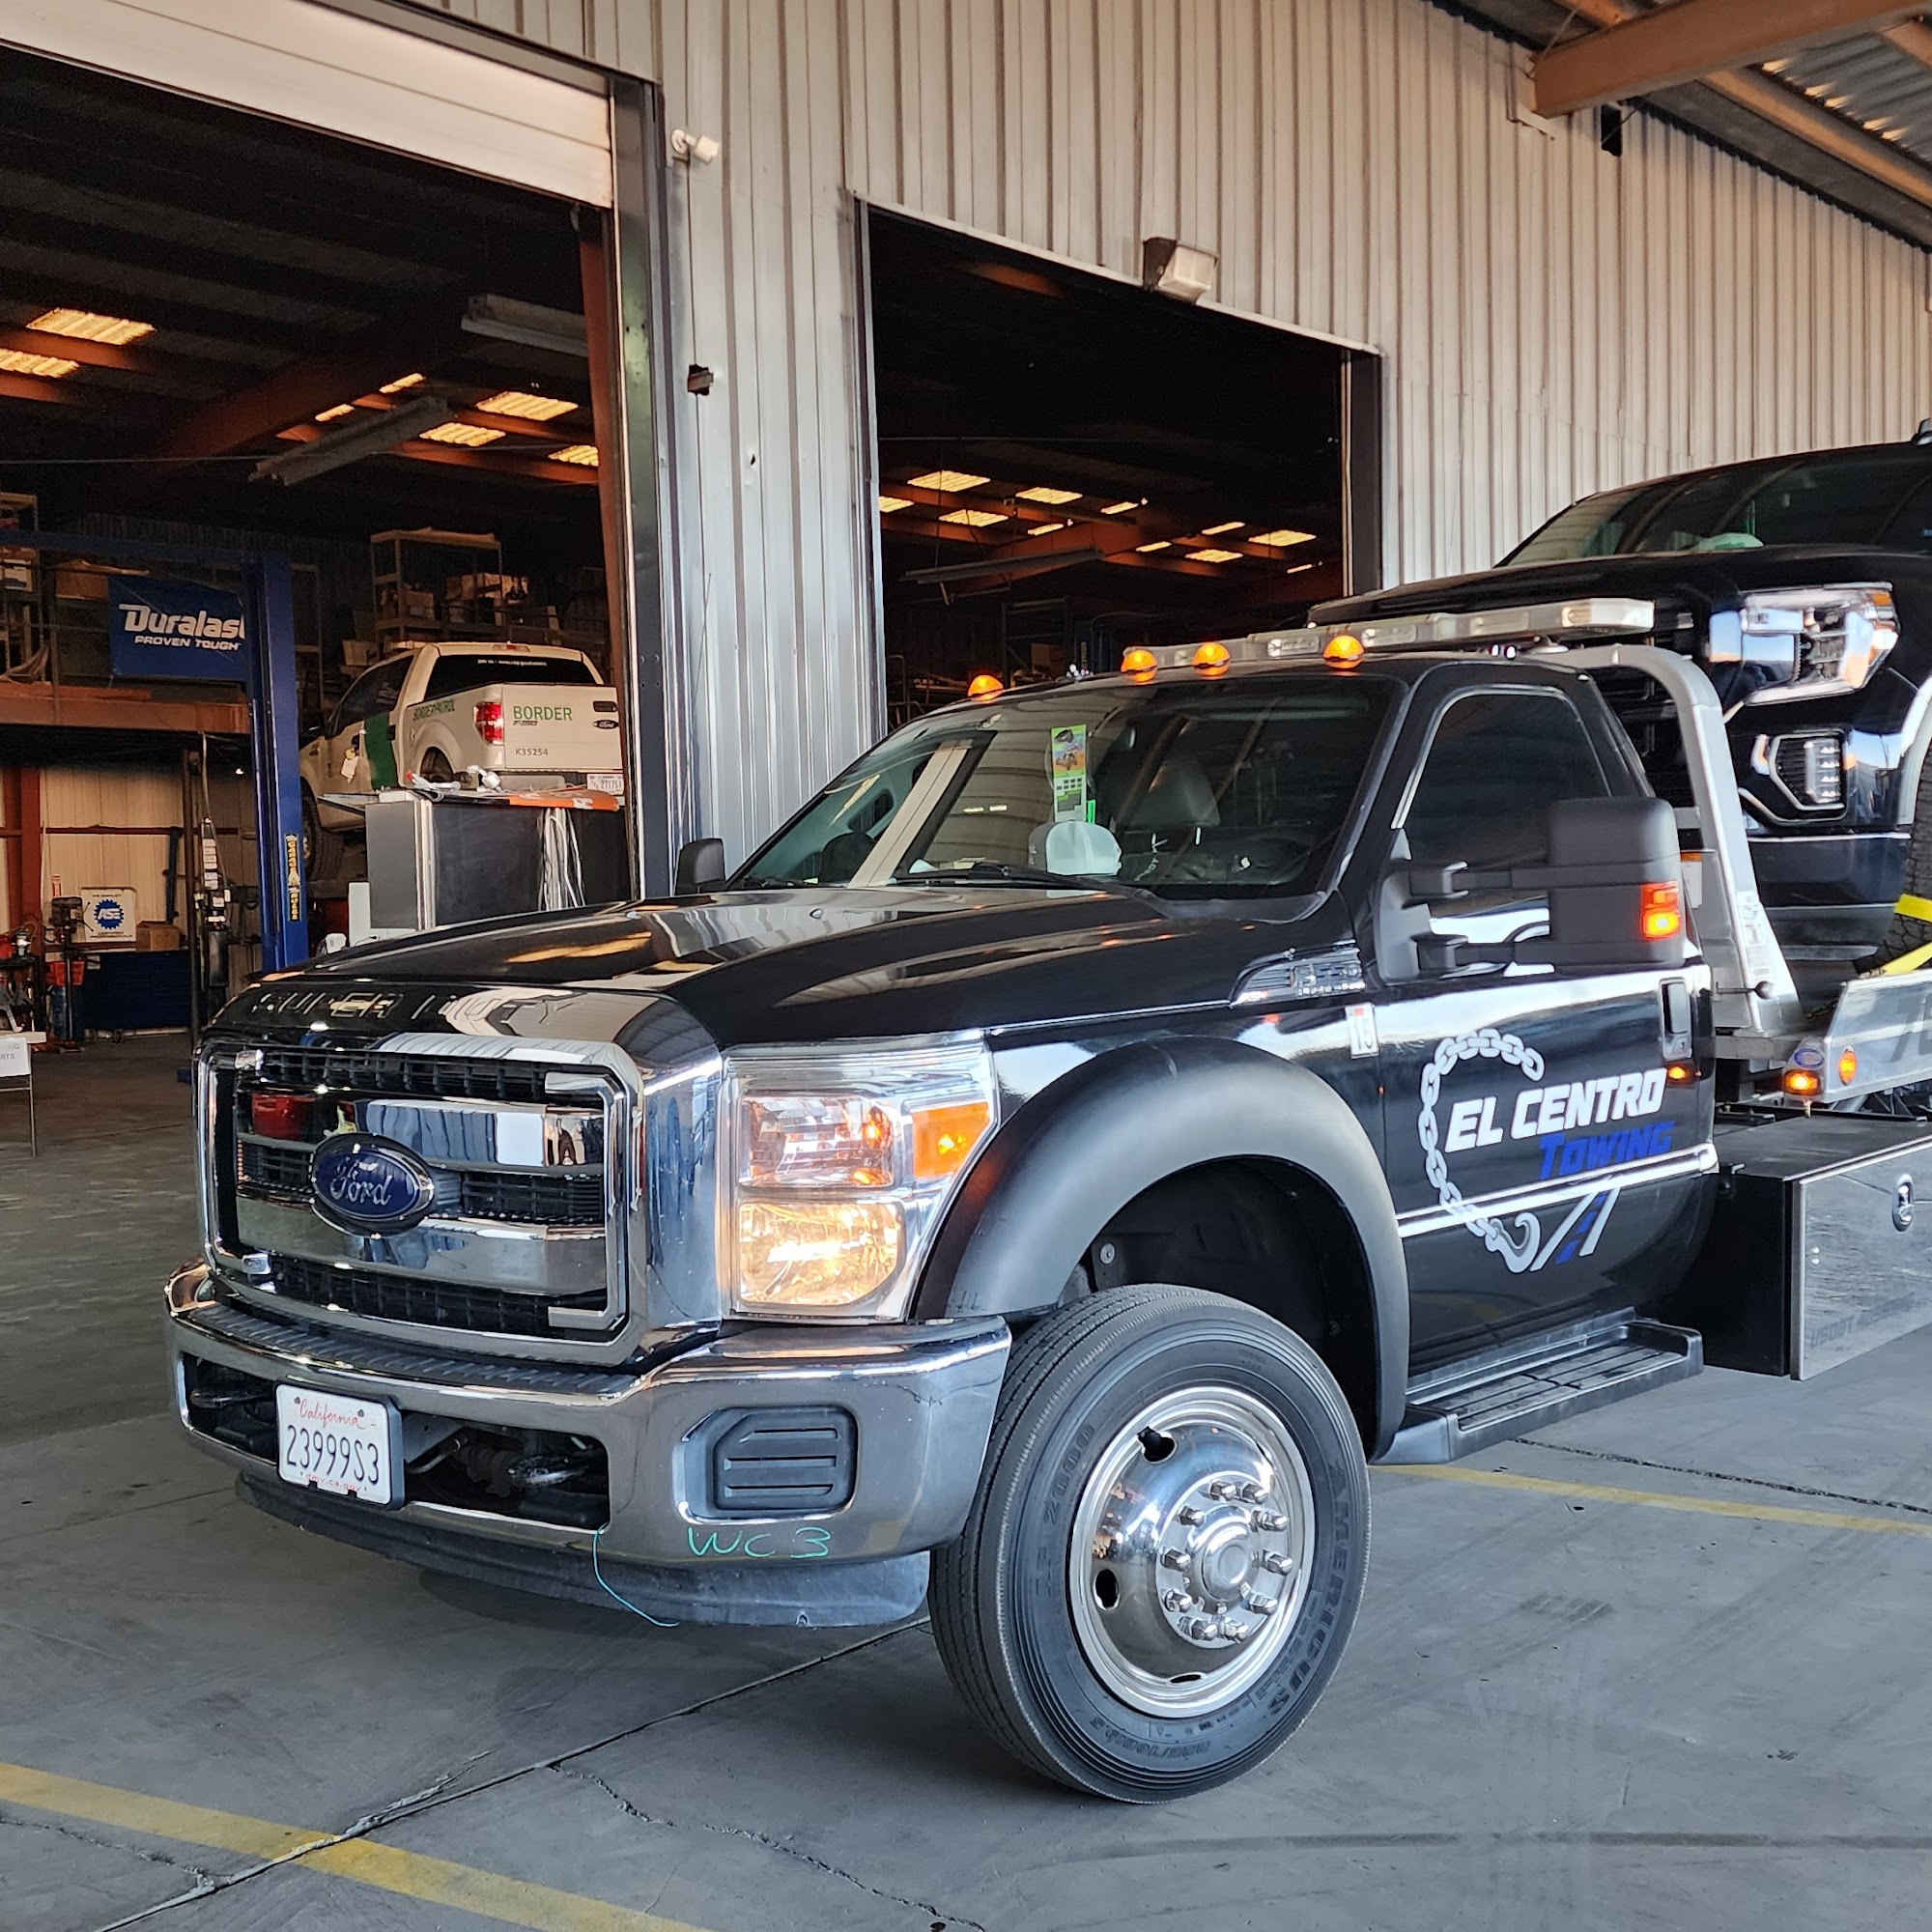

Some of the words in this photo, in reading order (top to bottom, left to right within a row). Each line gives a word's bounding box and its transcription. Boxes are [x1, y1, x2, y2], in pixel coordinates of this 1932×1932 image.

[134, 635, 191, 647] PROVEN
[194, 639, 239, 651] TOUGH
[513, 705, 573, 722] BORDER
[515, 748, 549, 756] K35254
[97, 908, 122, 921] ASE
[1443, 1096, 1504, 1153] EL
[1510, 1067, 1668, 1140] CENTRO
[1538, 1120, 1677, 1181] TOWING
[329, 1157, 393, 1207] Ford
[299, 1398, 366, 1431] California
[286, 1424, 380, 1486] 23999S3
[305, 1473, 361, 1492] dmv.ca.gov
[687, 1526, 776, 1558] WC
[789, 1526, 833, 1559] 3
[1267, 1459, 1351, 1717] AMERICUS
